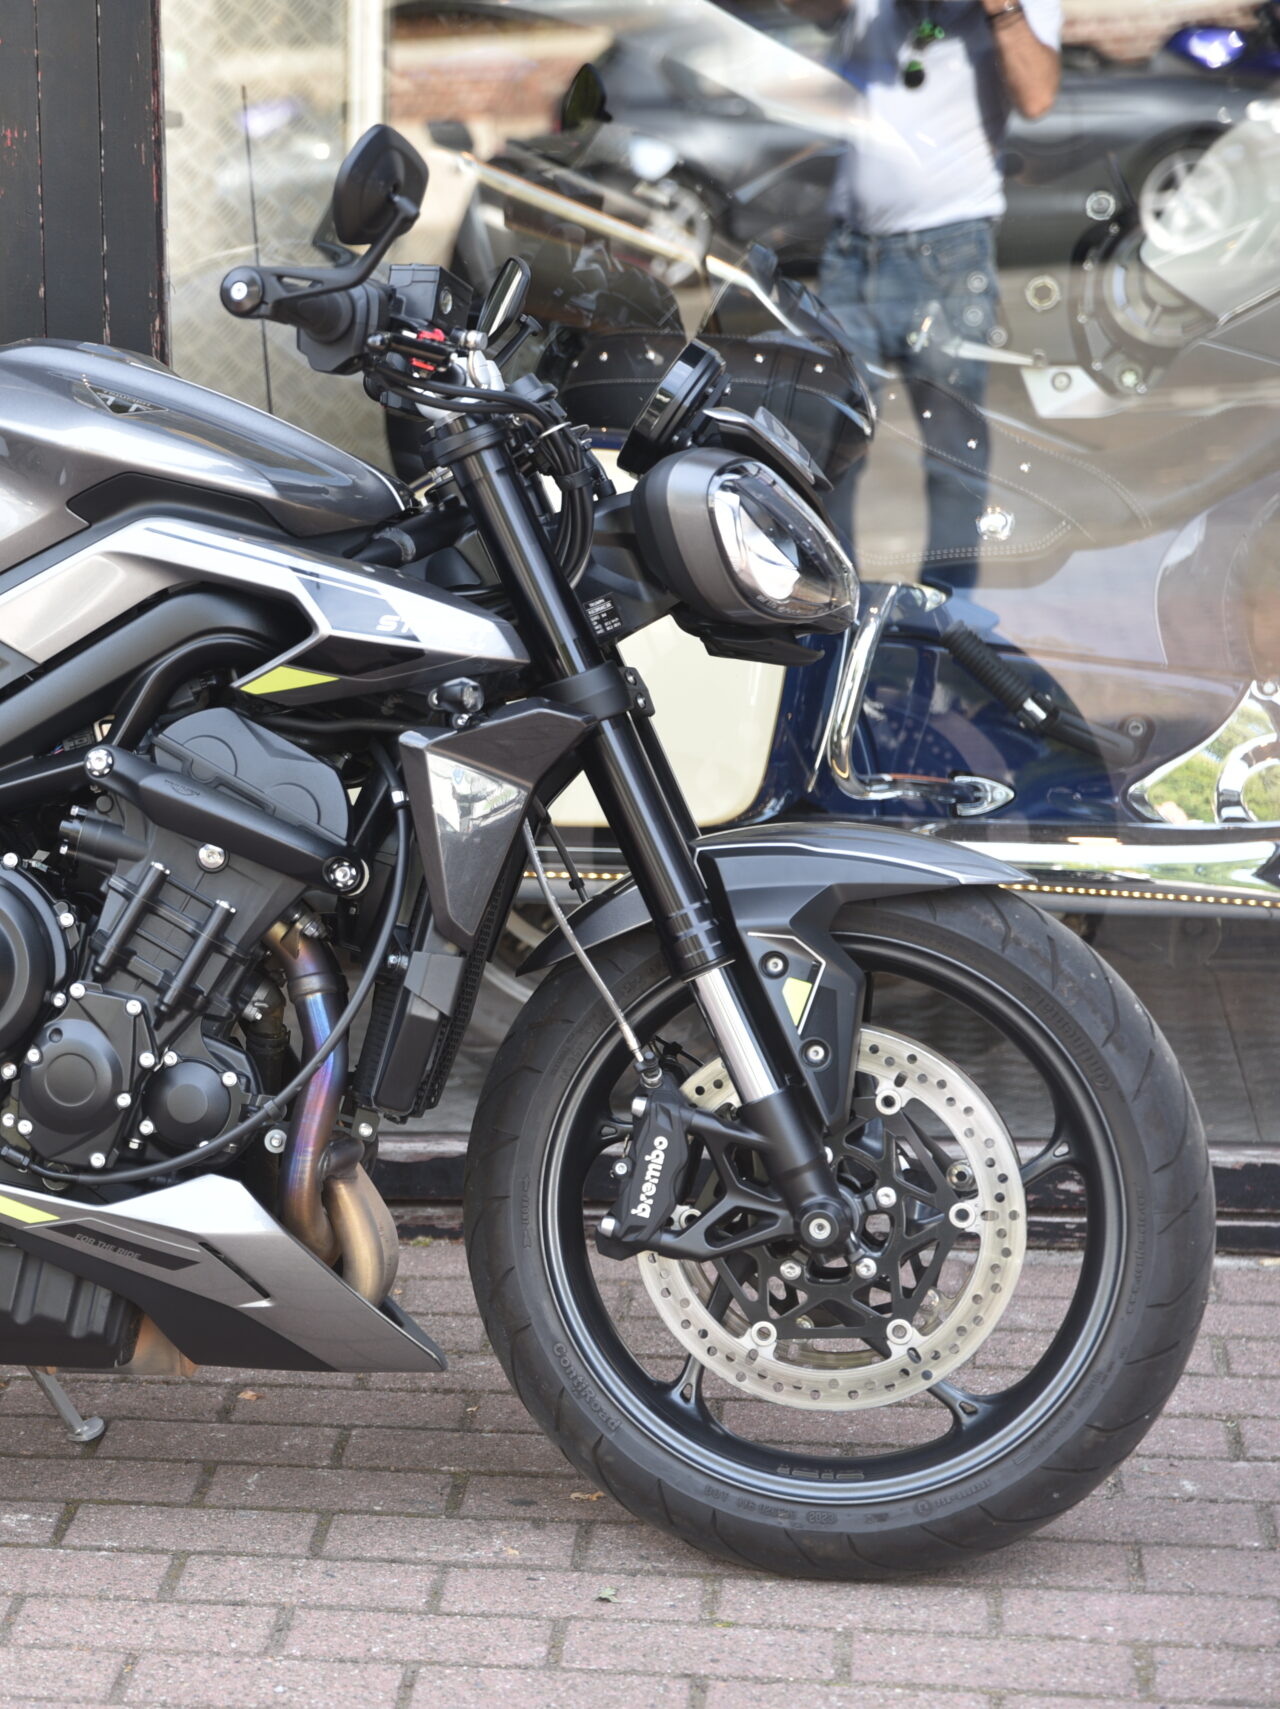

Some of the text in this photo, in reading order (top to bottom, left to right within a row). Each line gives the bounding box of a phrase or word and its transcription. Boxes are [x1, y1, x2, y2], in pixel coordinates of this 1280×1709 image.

[631, 1136, 669, 1219] brembo
[74, 1233, 142, 1260] FOR THE RIDE
[553, 1342, 621, 1432] ContiRoad
